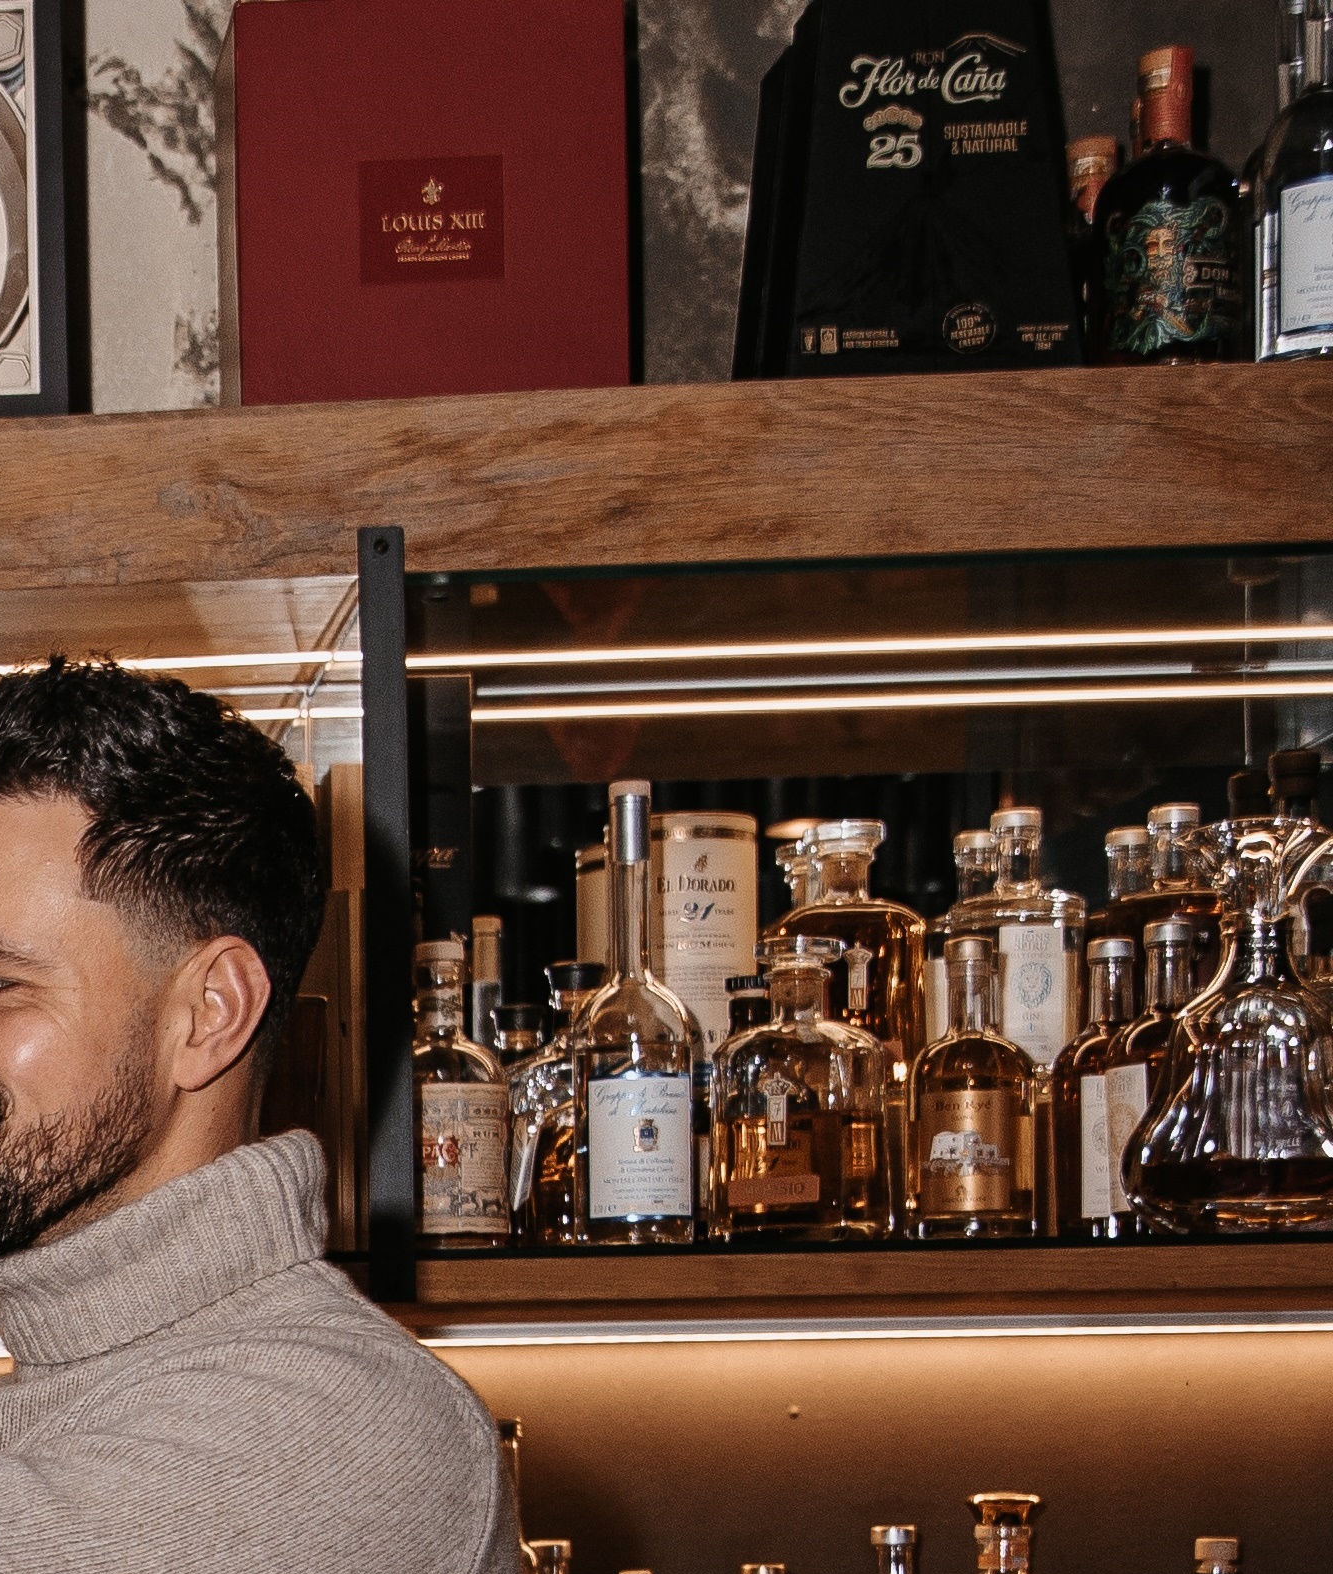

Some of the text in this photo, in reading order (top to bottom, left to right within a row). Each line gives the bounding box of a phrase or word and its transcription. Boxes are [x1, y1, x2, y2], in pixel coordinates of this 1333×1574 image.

[839, 53, 1006, 108] Flor de Caña
[943, 122, 1028, 140] SUSTAINABLE
[866, 134, 922, 168] 25
[951, 138, 1019, 155] & NATURAL
[381, 210, 485, 233] LOUIS XIII
[1201, 266, 1229, 282] DON
[678, 874, 736, 893] DORADO
[681, 902, 715, 922] 21
[935, 1101, 960, 1111] Ben
